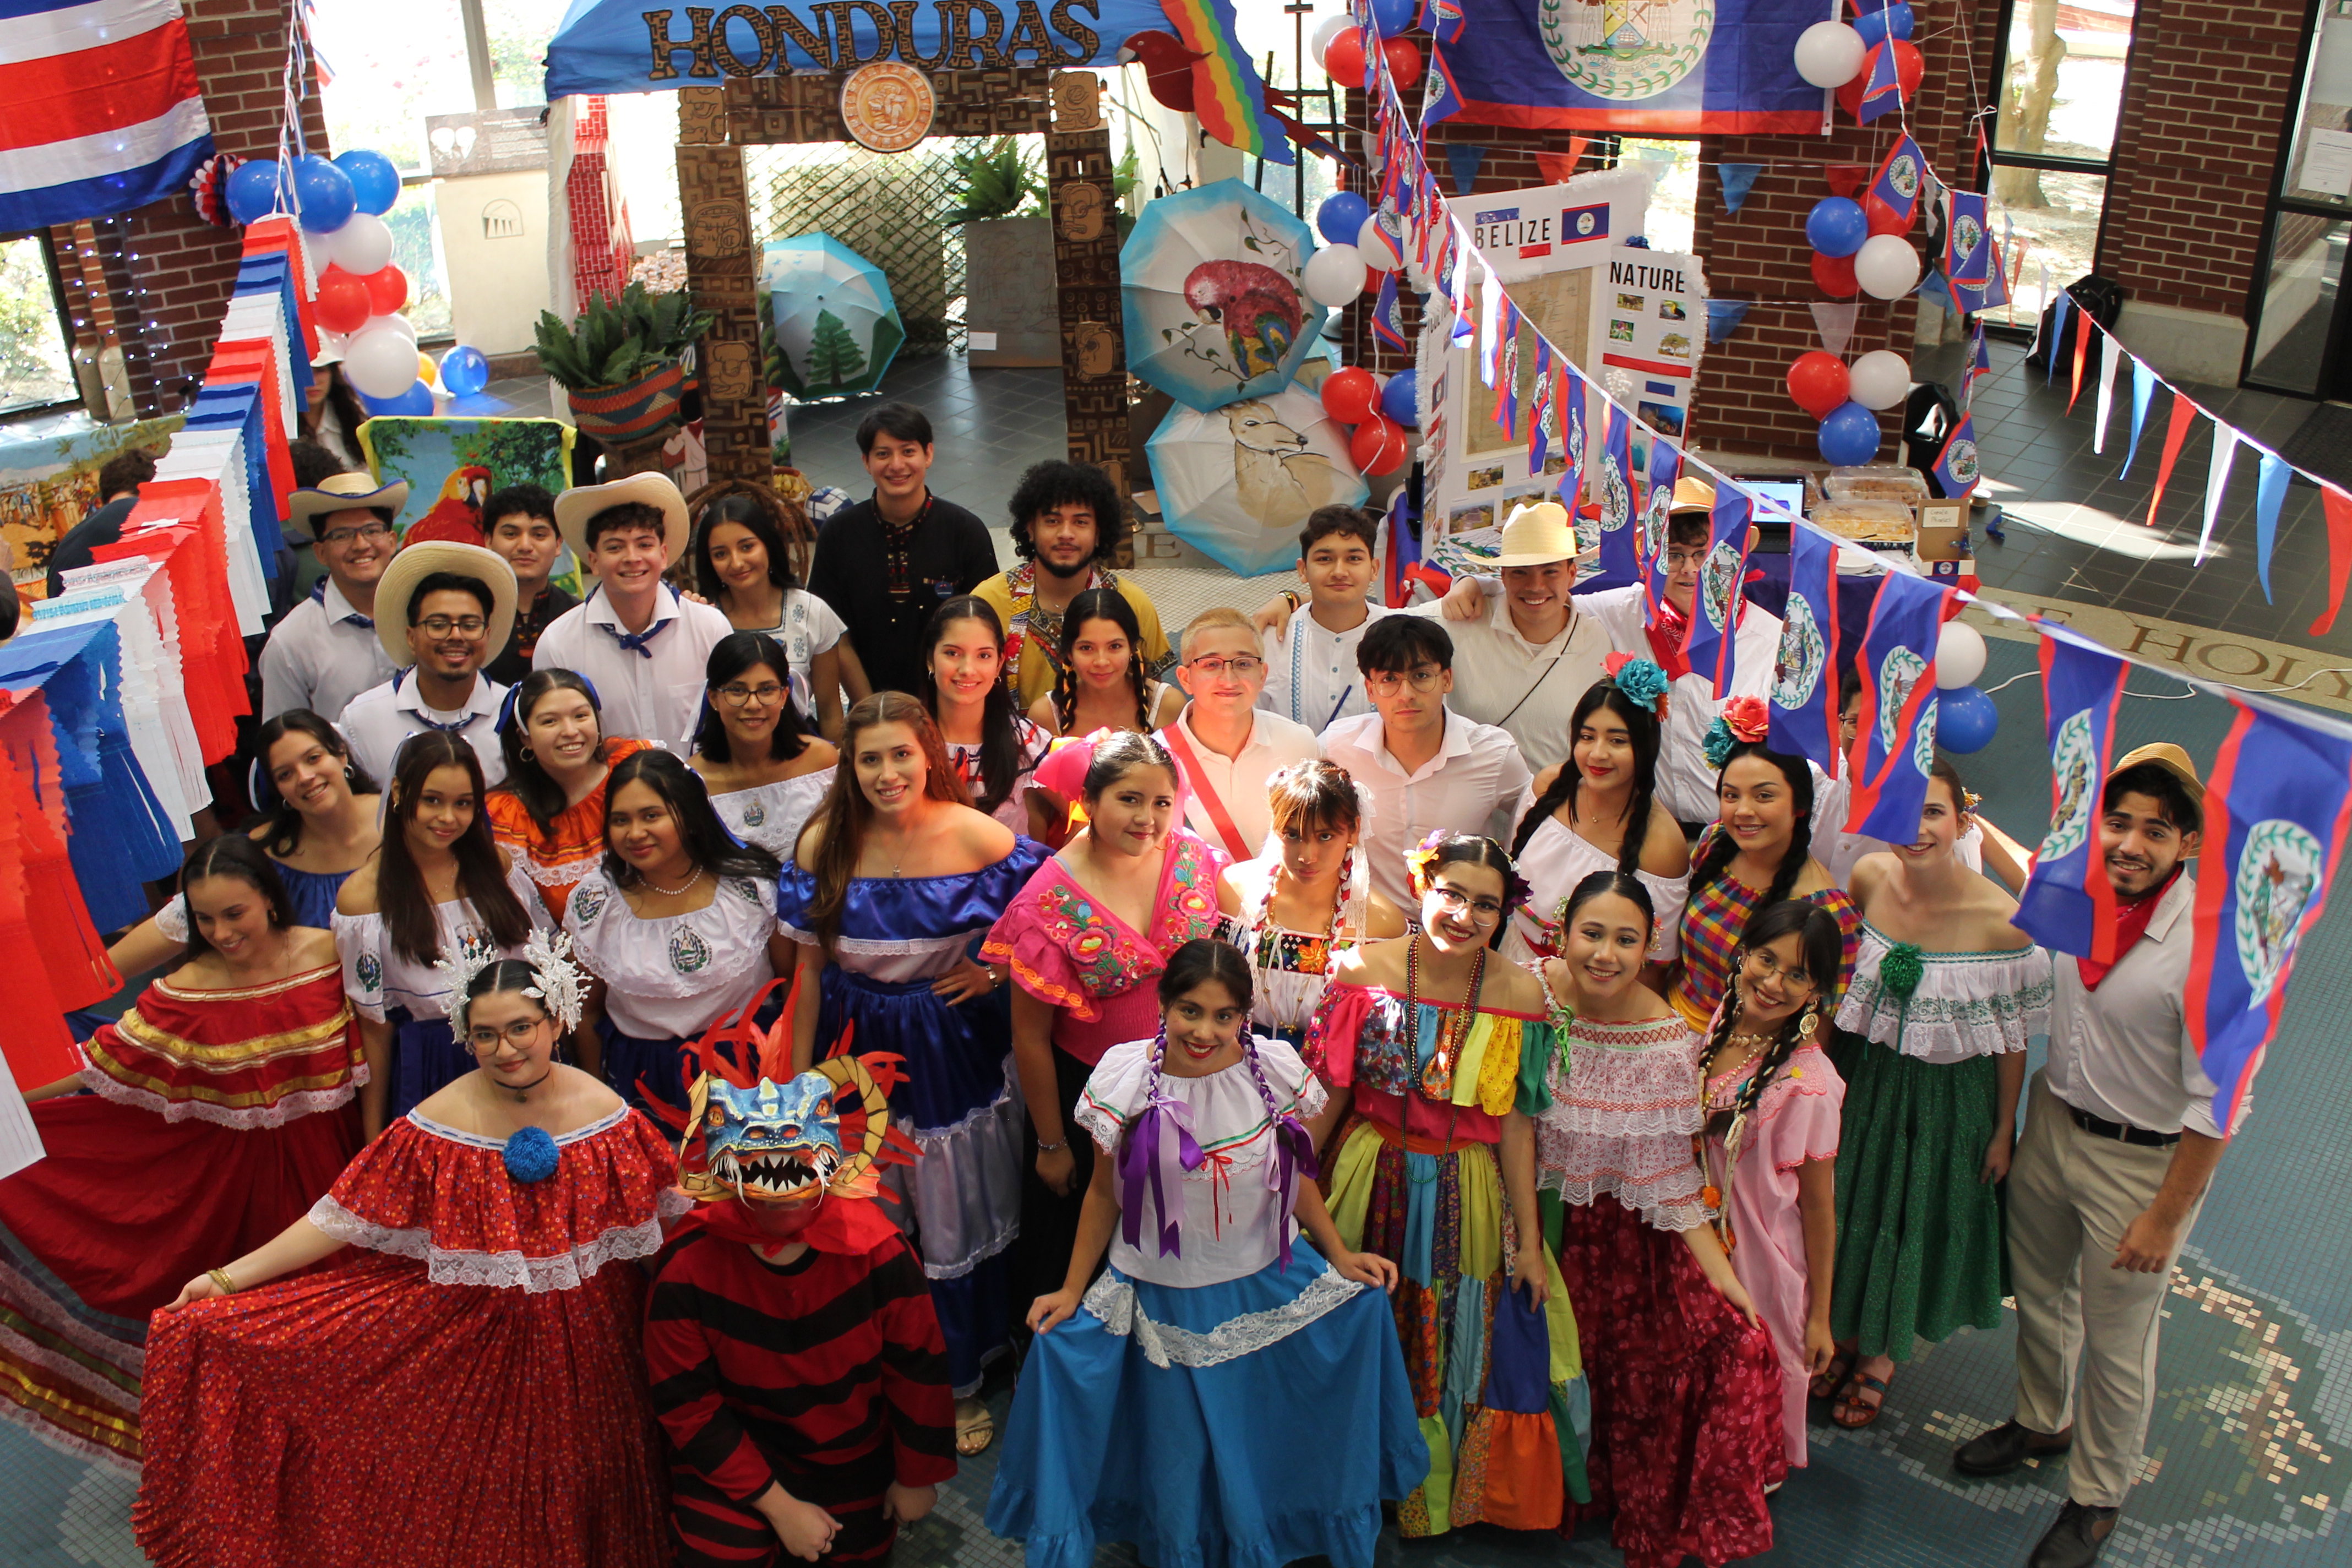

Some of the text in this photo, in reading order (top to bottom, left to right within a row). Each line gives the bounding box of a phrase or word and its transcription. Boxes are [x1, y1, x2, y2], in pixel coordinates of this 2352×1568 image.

[641, 0, 1100, 80] HONDURAS
[1474, 217, 1551, 249] BELIZE
[1609, 261, 1685, 293] NATURE
